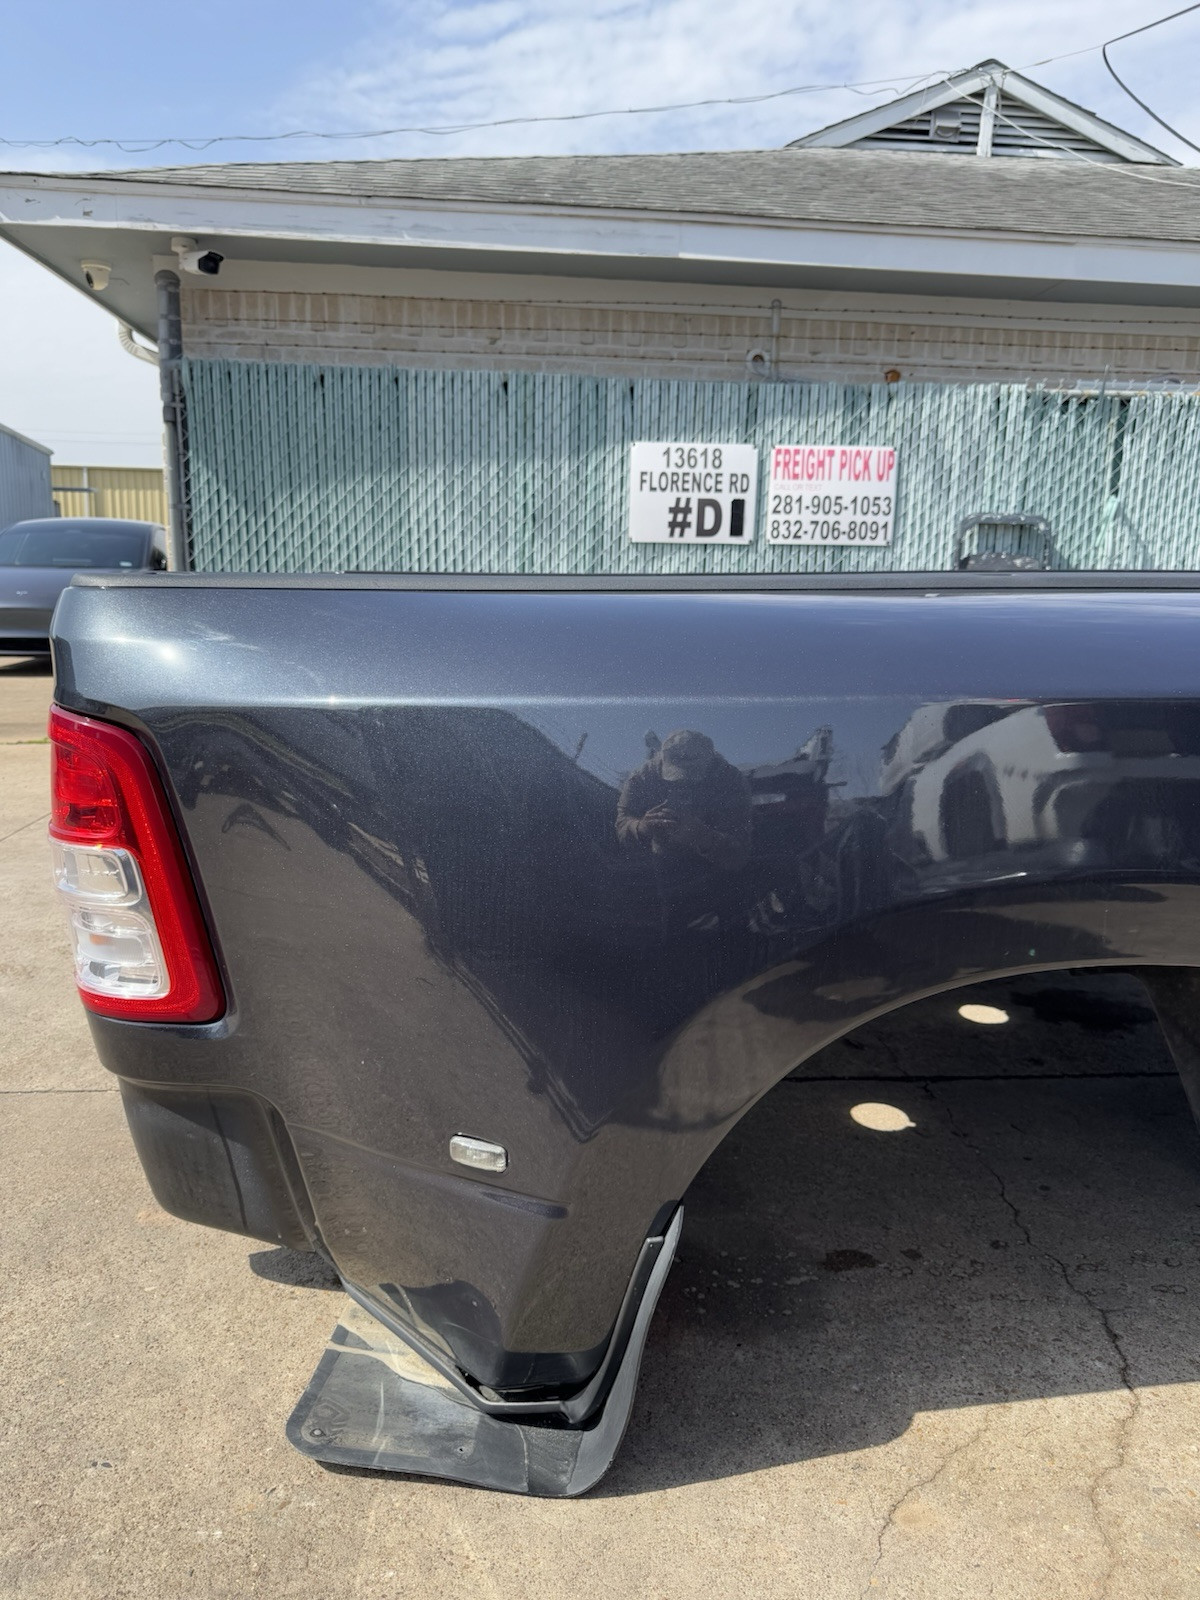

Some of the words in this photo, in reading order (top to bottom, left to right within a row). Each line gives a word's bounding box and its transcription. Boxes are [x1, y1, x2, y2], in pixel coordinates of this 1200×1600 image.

[662, 447, 723, 469] 13618
[773, 448, 835, 481] FREIGHT
[839, 449, 872, 481] PICK
[877, 449, 895, 481] UP
[639, 471, 724, 493] FLORENCE
[729, 473, 750, 494] RD
[772, 494, 892, 516] 281-905-1053
[770, 519, 890, 541] 832-706-8091
